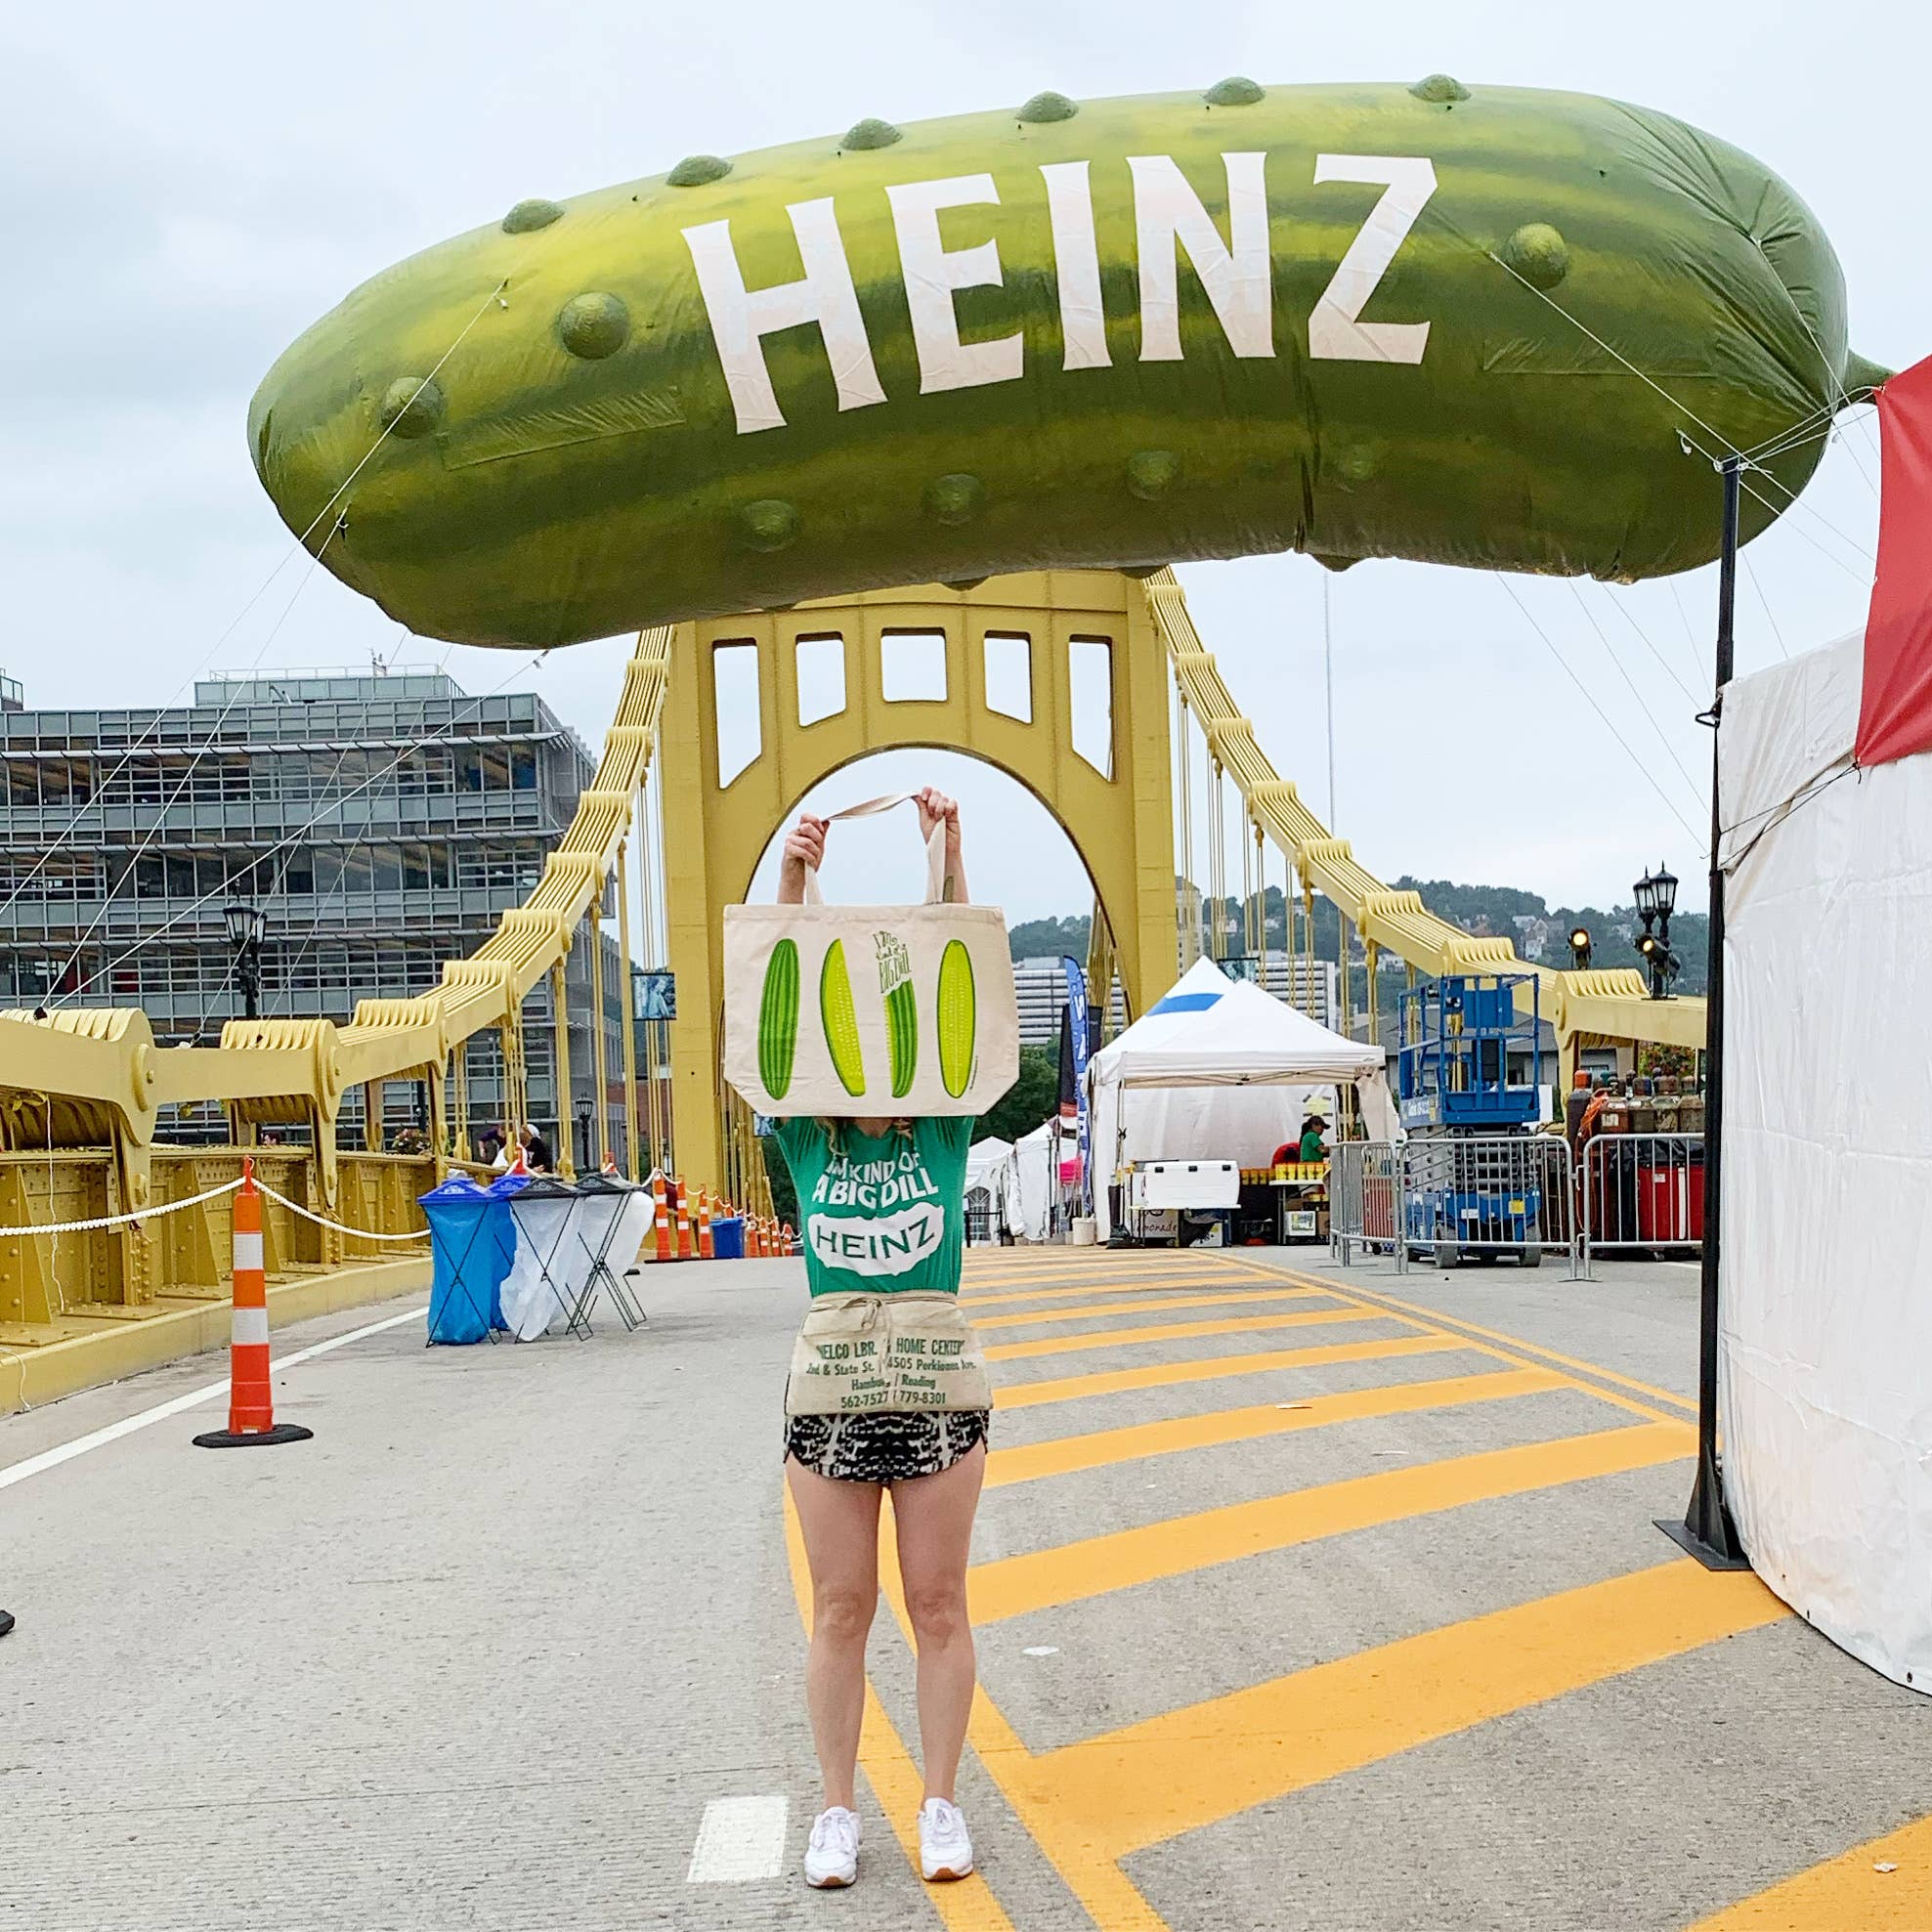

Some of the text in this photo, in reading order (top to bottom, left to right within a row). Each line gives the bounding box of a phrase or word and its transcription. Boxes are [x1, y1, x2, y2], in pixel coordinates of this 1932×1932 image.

[680, 151, 1438, 435] HEINZ
[849, 1160, 896, 1184] KIND
[898, 1151, 921, 1173] OF
[811, 1167, 939, 1210] A BIG DILL
[816, 1216, 935, 1260] HEINZ
[896, 1337, 926, 1354] HOME
[823, 1363, 832, 1376] &
[836, 1363, 859, 1376] State
[901, 1373, 936, 1390] Reading
[900, 1390, 947, 1405] 779-8301
